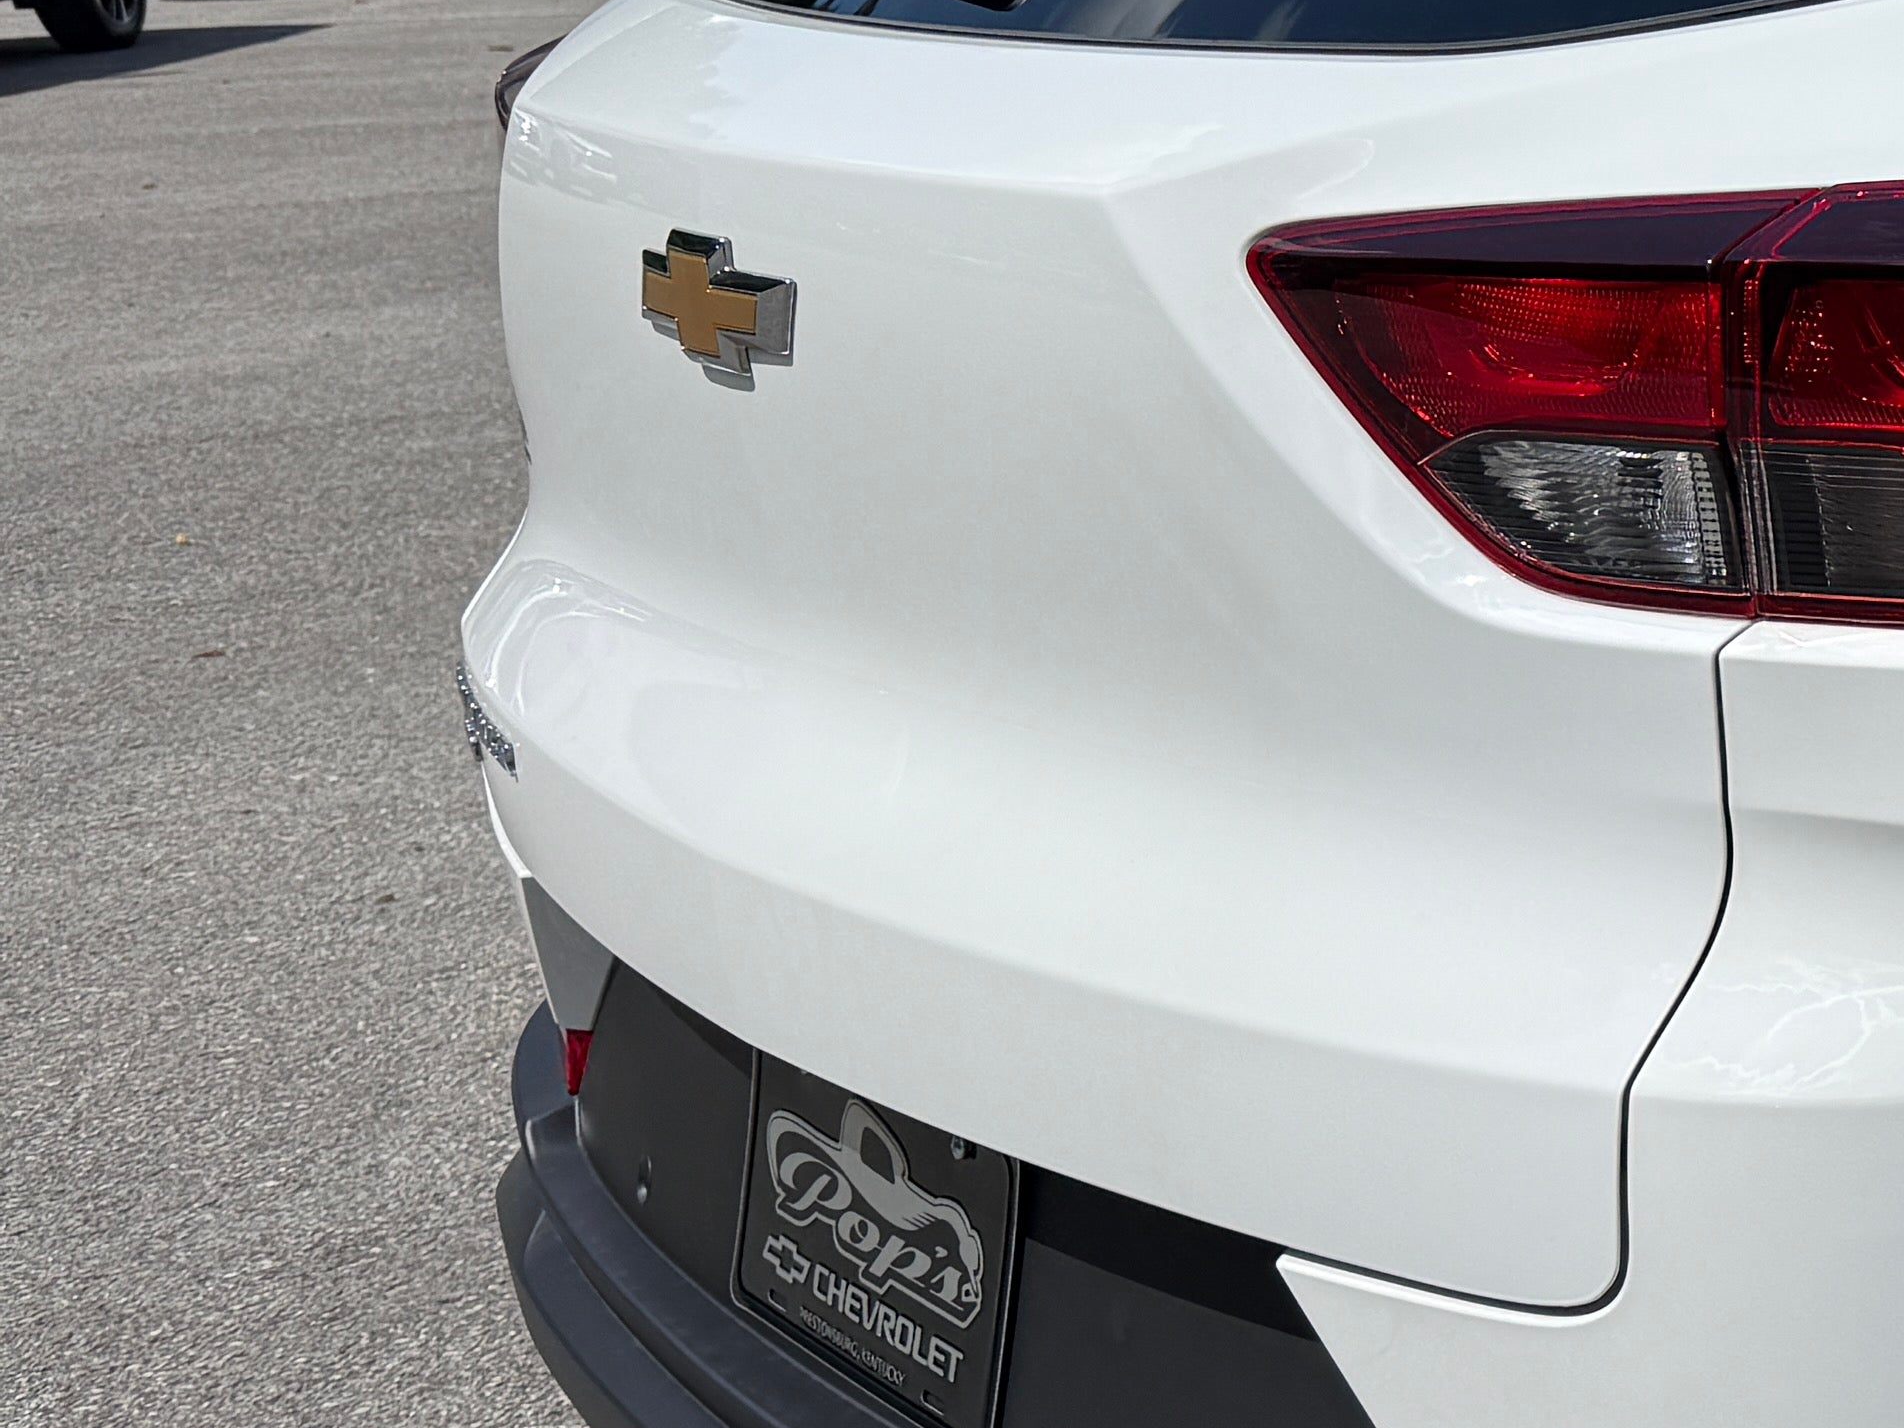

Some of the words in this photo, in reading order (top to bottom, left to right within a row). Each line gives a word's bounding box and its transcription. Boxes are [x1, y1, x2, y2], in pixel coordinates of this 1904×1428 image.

[777, 1151, 966, 1312] Pop's
[812, 1262, 965, 1384] CHEVROLET
[862, 1347, 907, 1388] KENTUCKY
